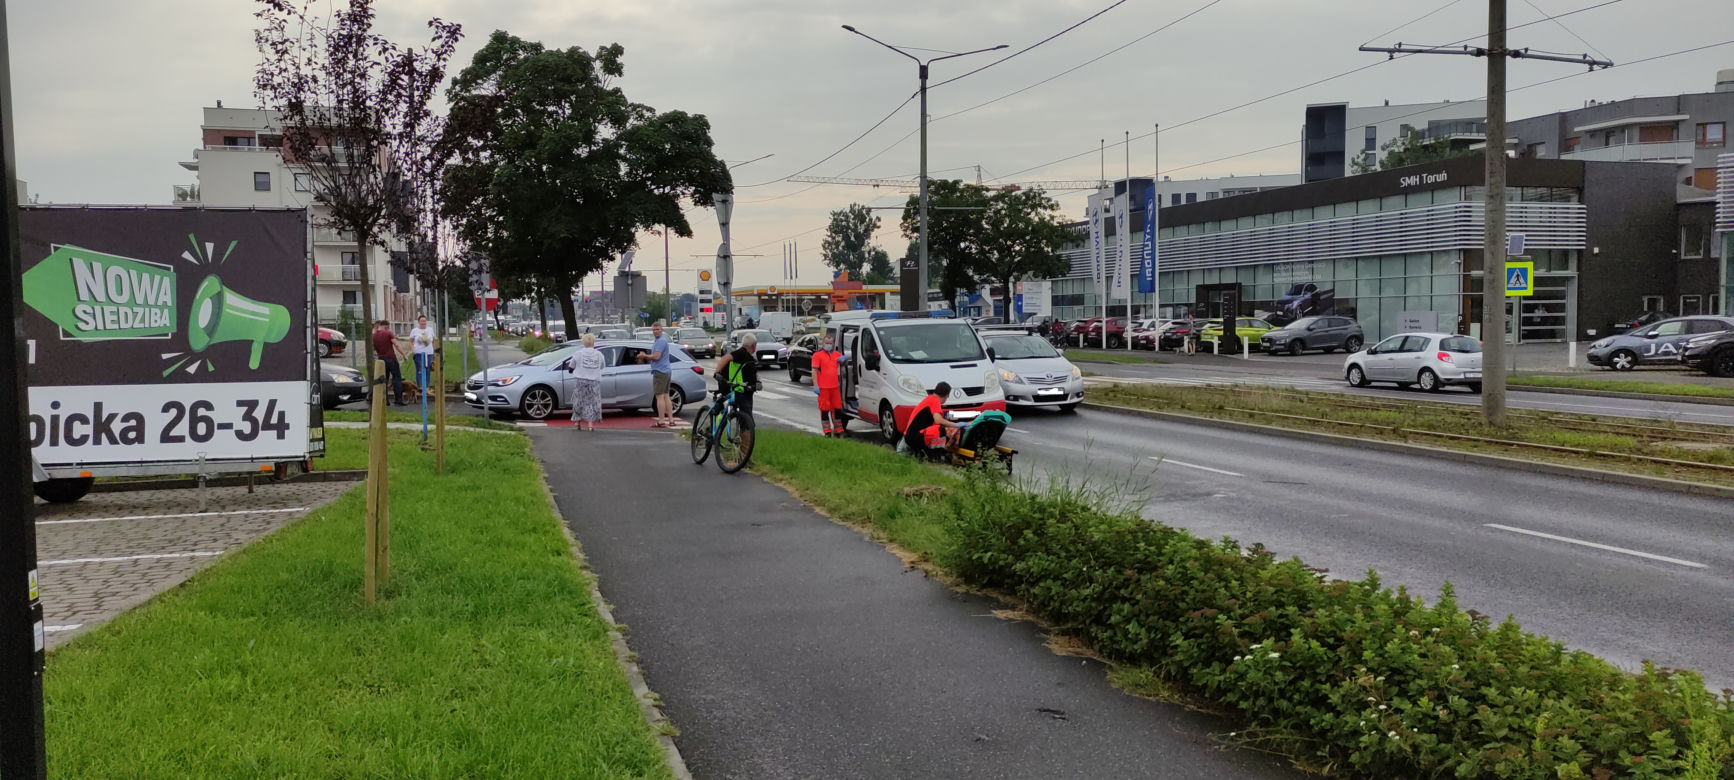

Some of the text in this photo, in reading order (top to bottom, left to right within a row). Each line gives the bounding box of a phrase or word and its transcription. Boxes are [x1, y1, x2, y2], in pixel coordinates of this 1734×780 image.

[1400, 170, 1448, 188] SMH Toruń
[70, 257, 172, 306] NOWA
[74, 304, 170, 331] SIEDZIBA
[159, 399, 290, 444] 26-34
